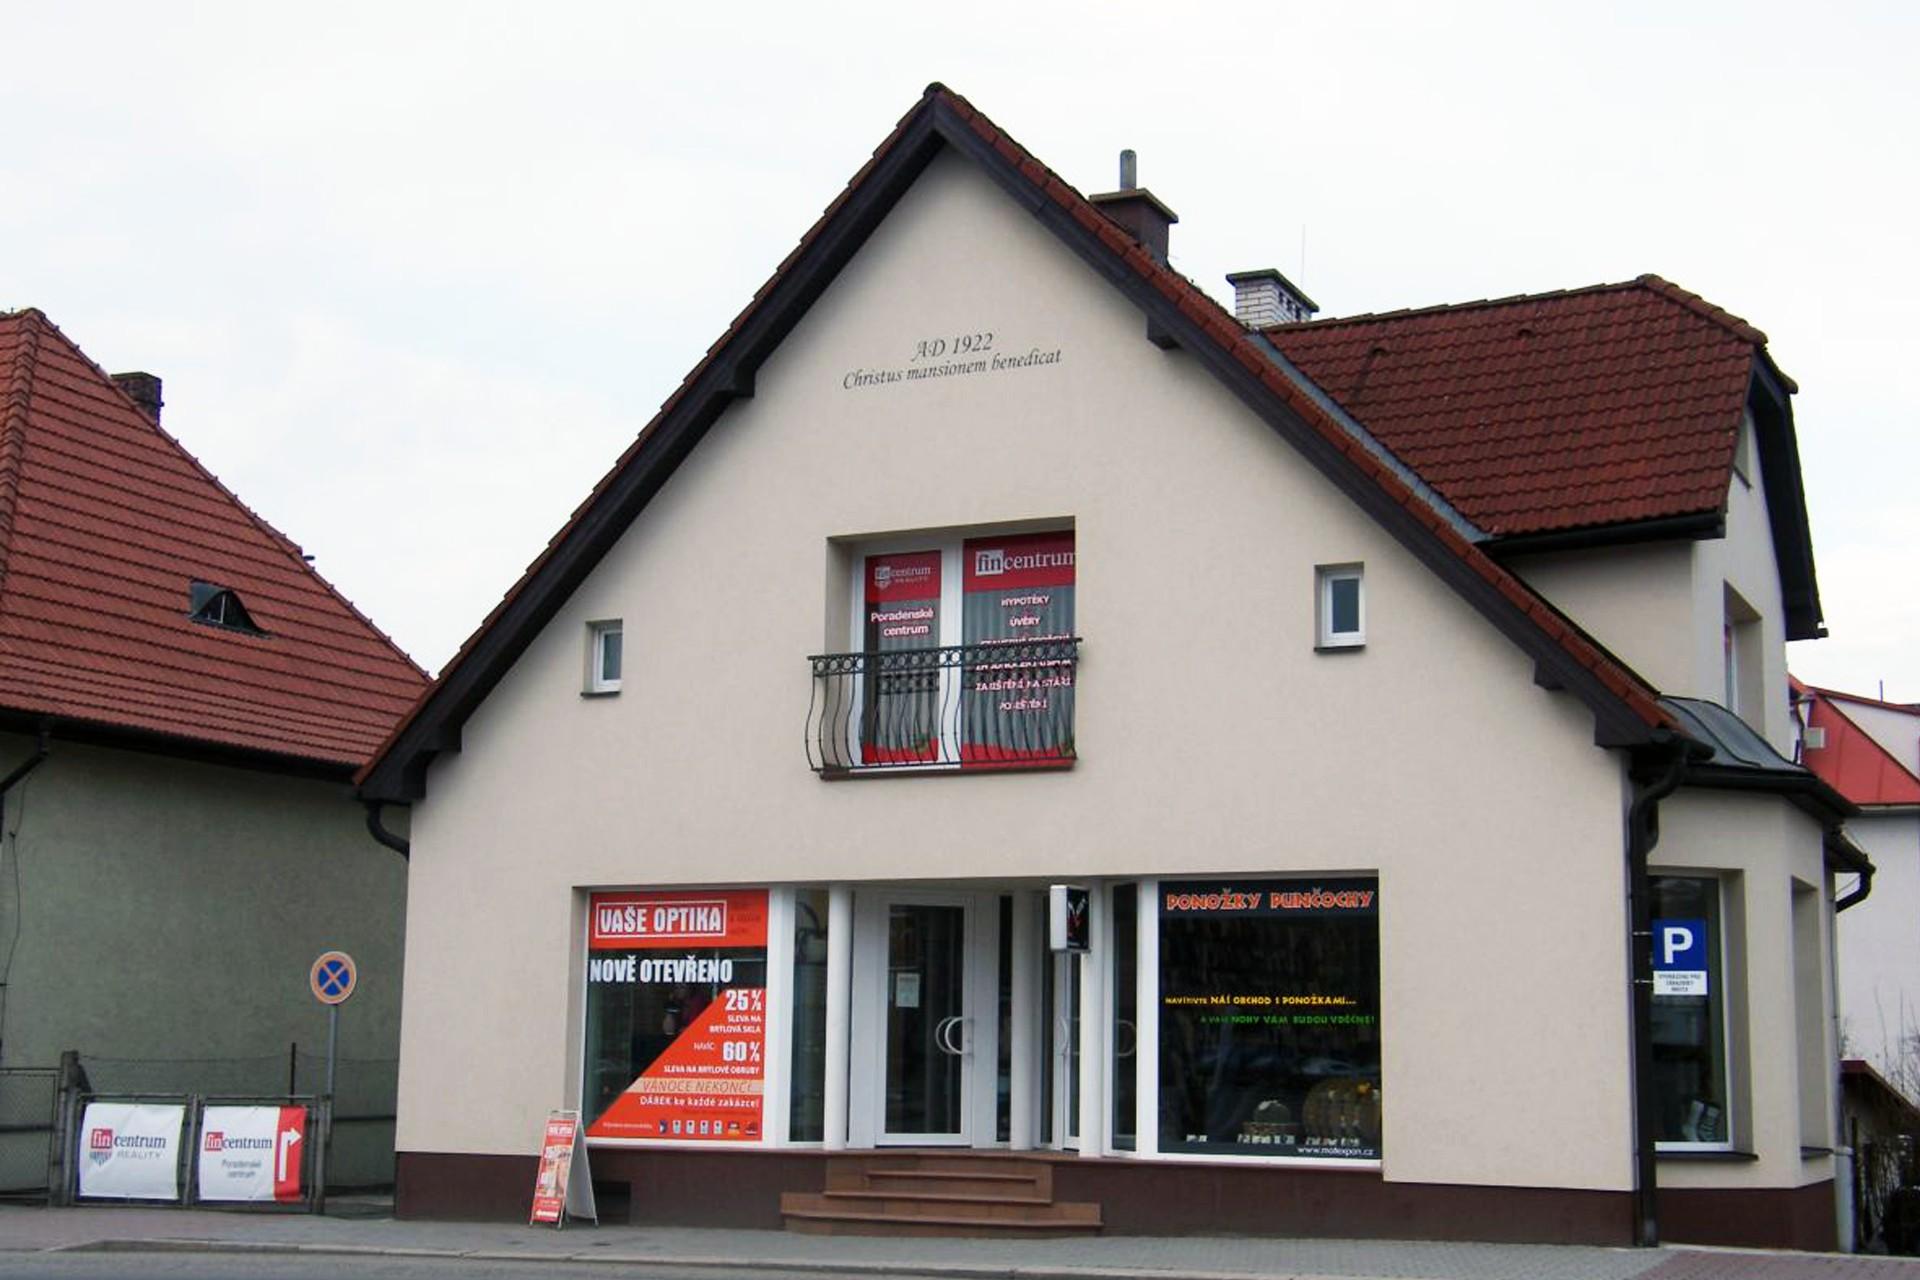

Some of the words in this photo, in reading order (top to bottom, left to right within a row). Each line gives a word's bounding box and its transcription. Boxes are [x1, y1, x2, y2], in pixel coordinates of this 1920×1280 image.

[911, 340, 946, 362] AD
[953, 332, 994, 355] 1922
[843, 368, 902, 390] Christus
[907, 359, 987, 381] mansionem
[991, 348, 1062, 371] benedicat
[870, 607, 934, 622] Poradenské
[883, 625, 929, 636] centrum
[1166, 888, 1261, 910] PONOŽKY
[1270, 887, 1374, 909] PUNČOCHY
[600, 906, 647, 933] VAŠE
[653, 902, 721, 932] OPTIKA
[1664, 927, 1693, 964] P
[590, 955, 636, 983] NOVĚ
[640, 954, 733, 983] OTEVŘENO
[91, 1128, 167, 1149] fincentrum
[205, 1131, 272, 1151] fincentrum
